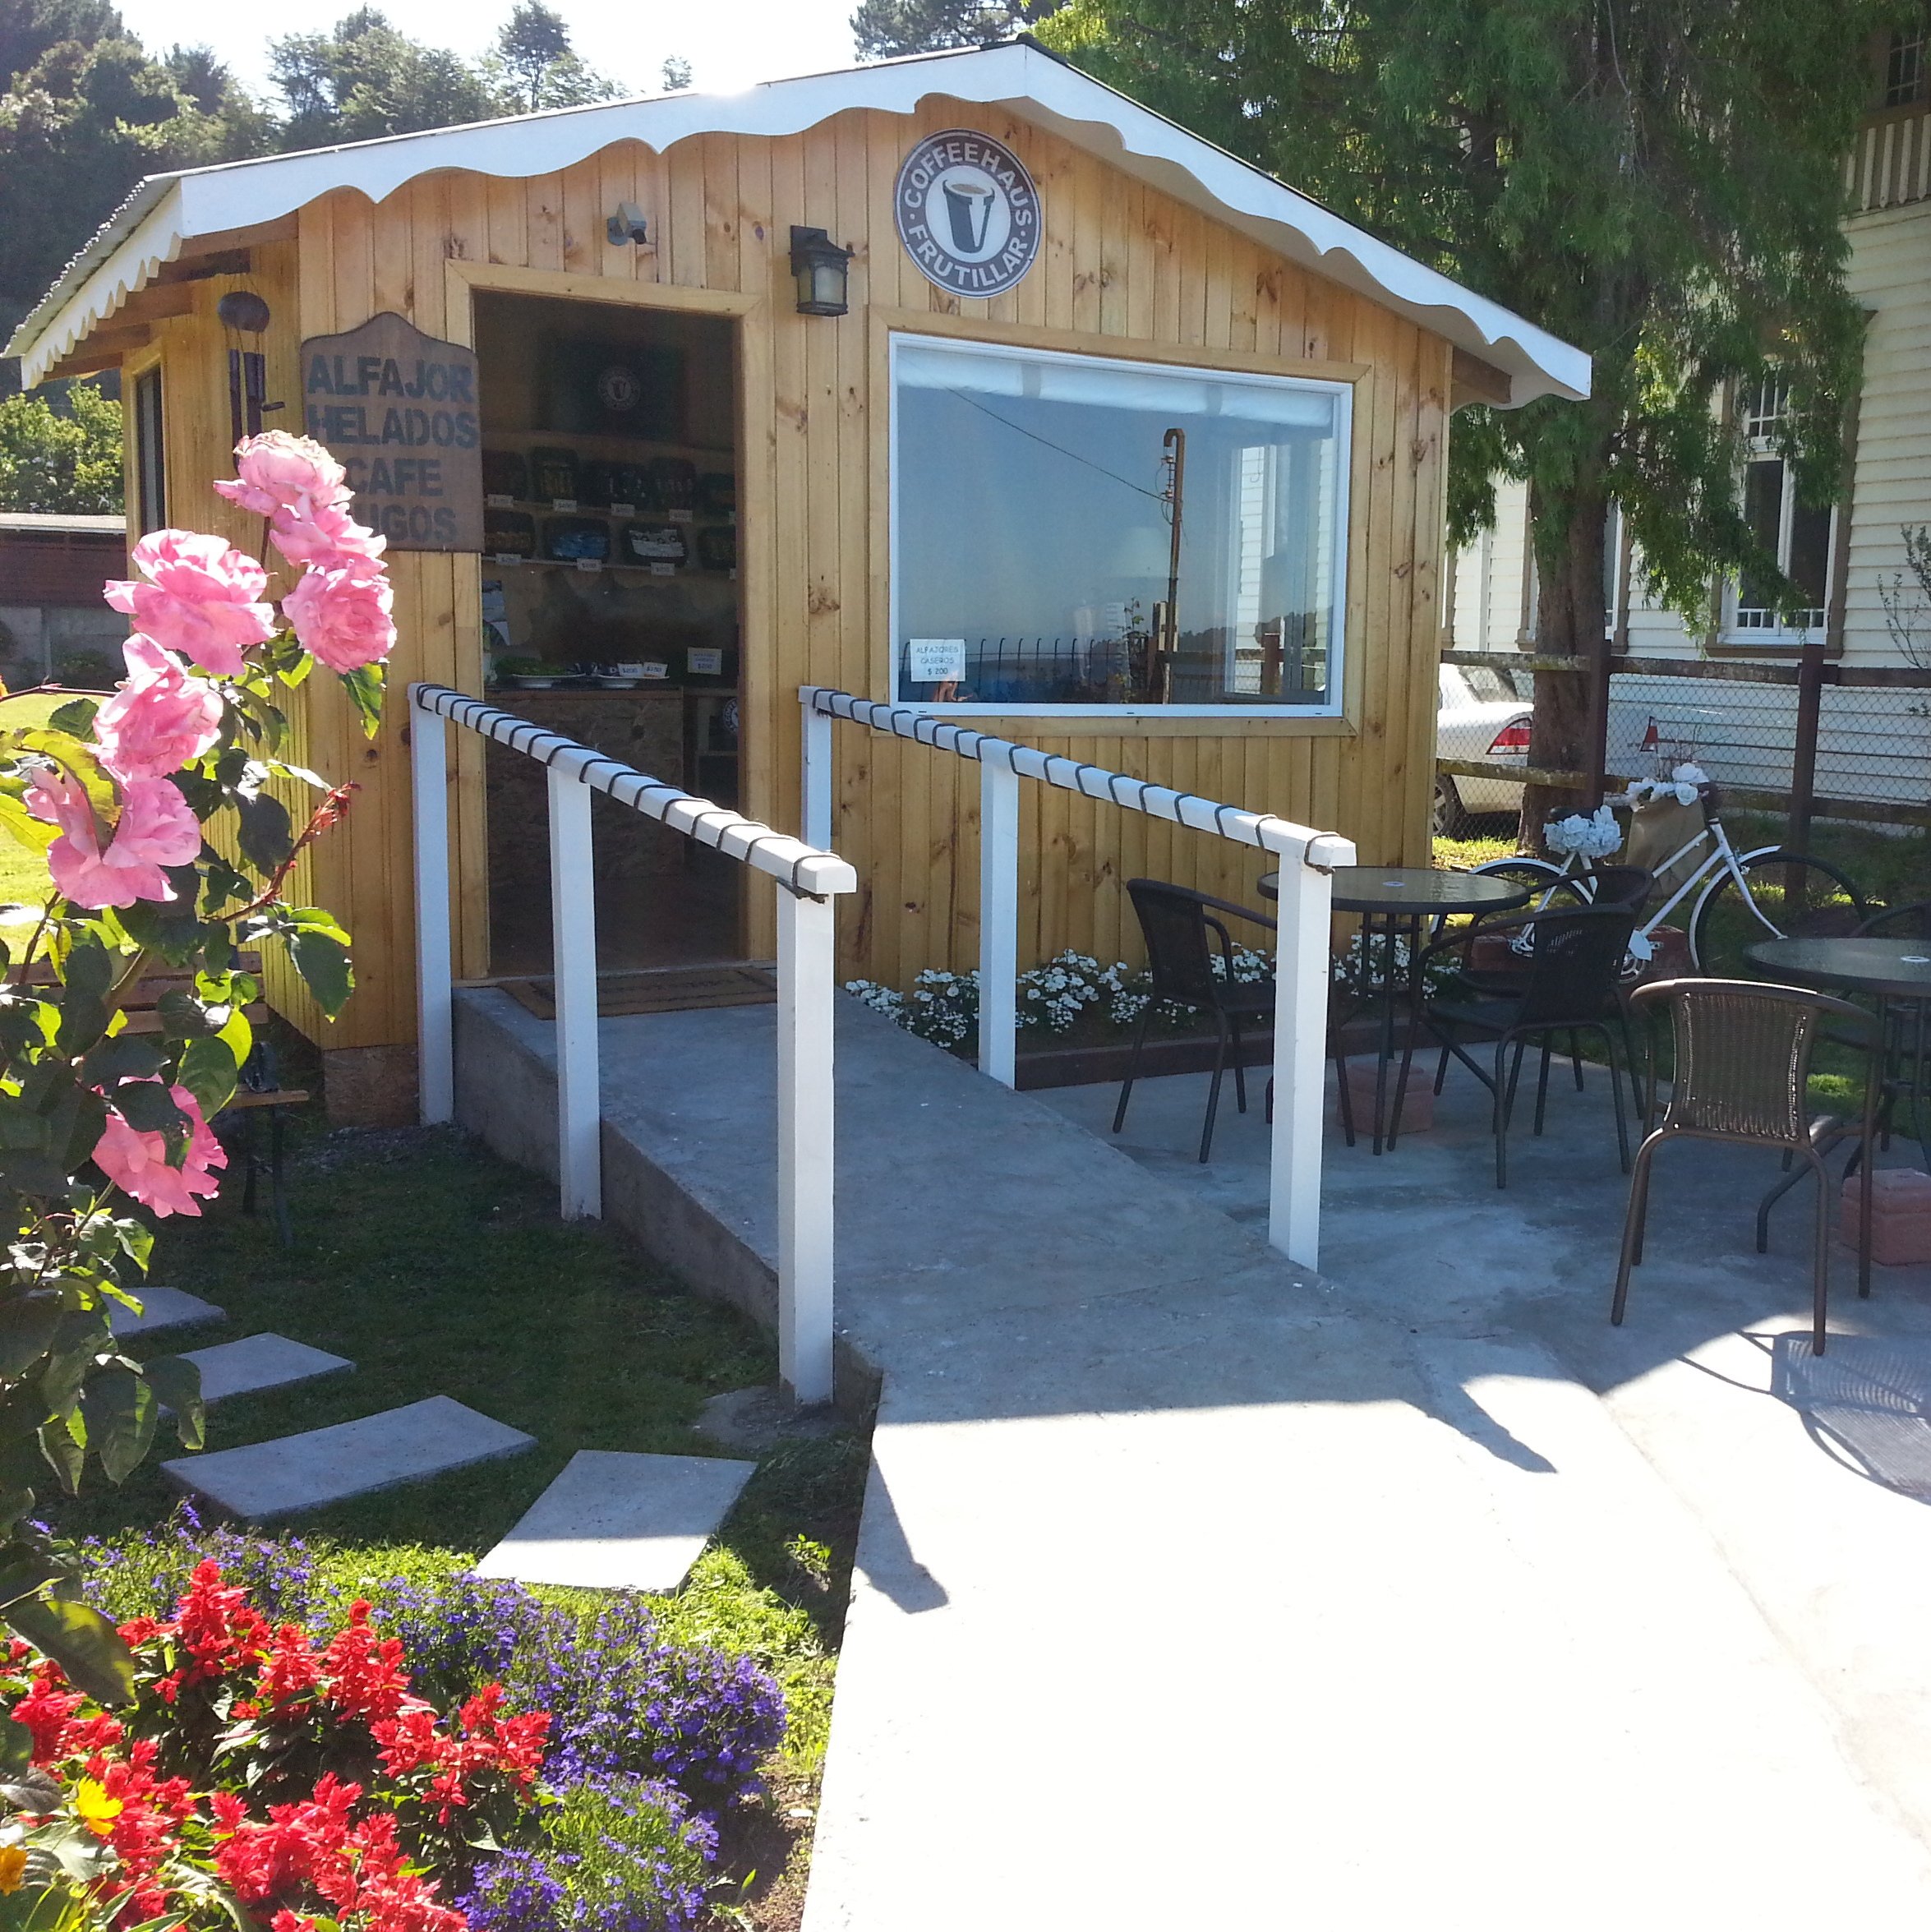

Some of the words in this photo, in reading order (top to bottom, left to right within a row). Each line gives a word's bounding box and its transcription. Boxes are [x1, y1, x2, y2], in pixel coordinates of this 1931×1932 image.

[905, 142, 1031, 227] COFFEEHAUS
[908, 224, 1027, 288] FRUTILLAR
[307, 355, 473, 403] ALFAJOR
[306, 403, 478, 449] HELADOS
[345, 456, 443, 496] CAFE
